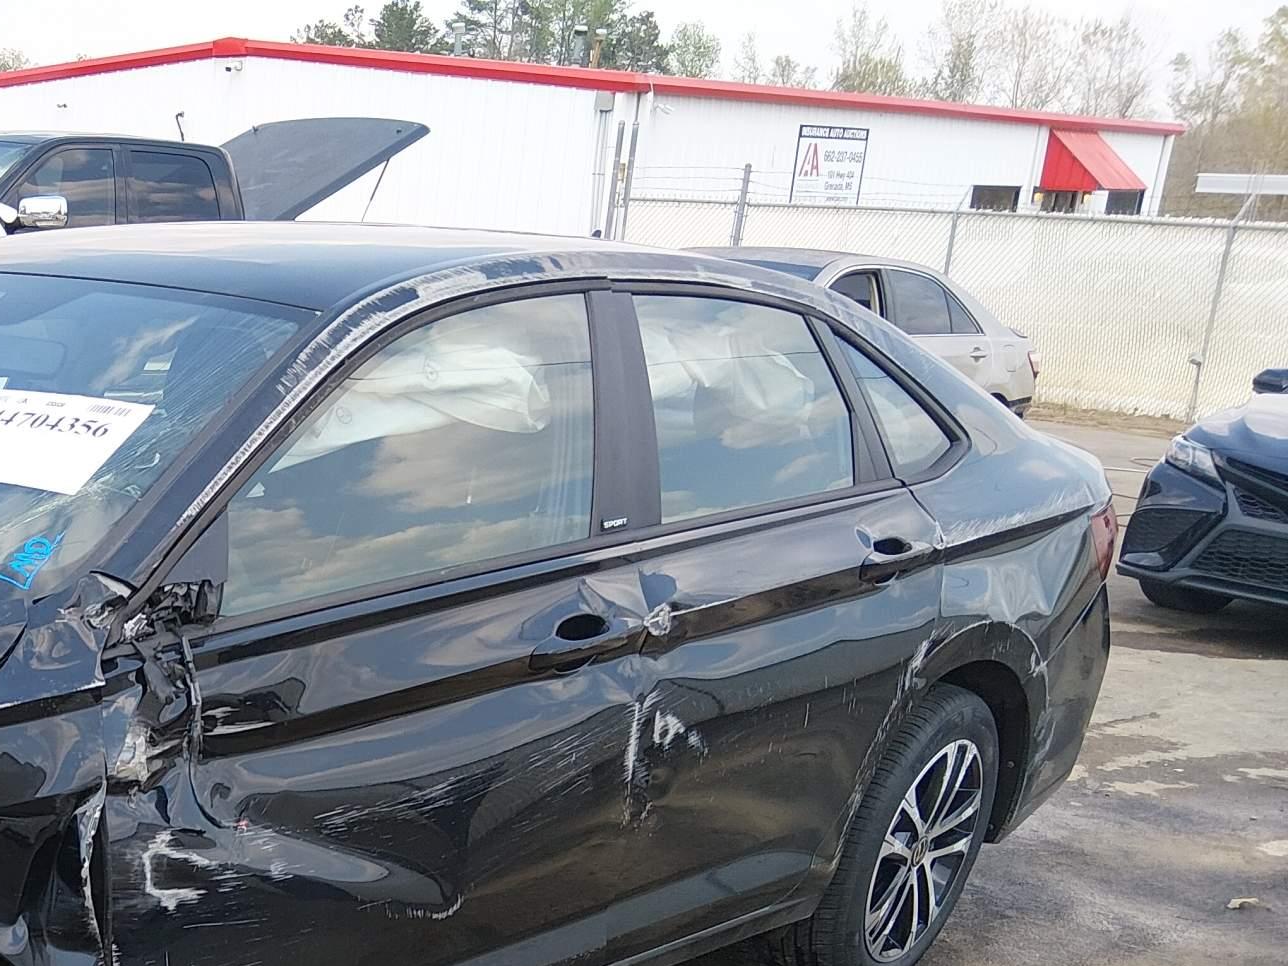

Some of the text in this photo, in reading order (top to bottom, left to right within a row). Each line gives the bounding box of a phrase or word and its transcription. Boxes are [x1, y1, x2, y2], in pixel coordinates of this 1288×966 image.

[802, 127, 830, 138] INSURANCE
[830, 128, 844, 138] AUTO
[603, 518, 628, 529] SPORT
